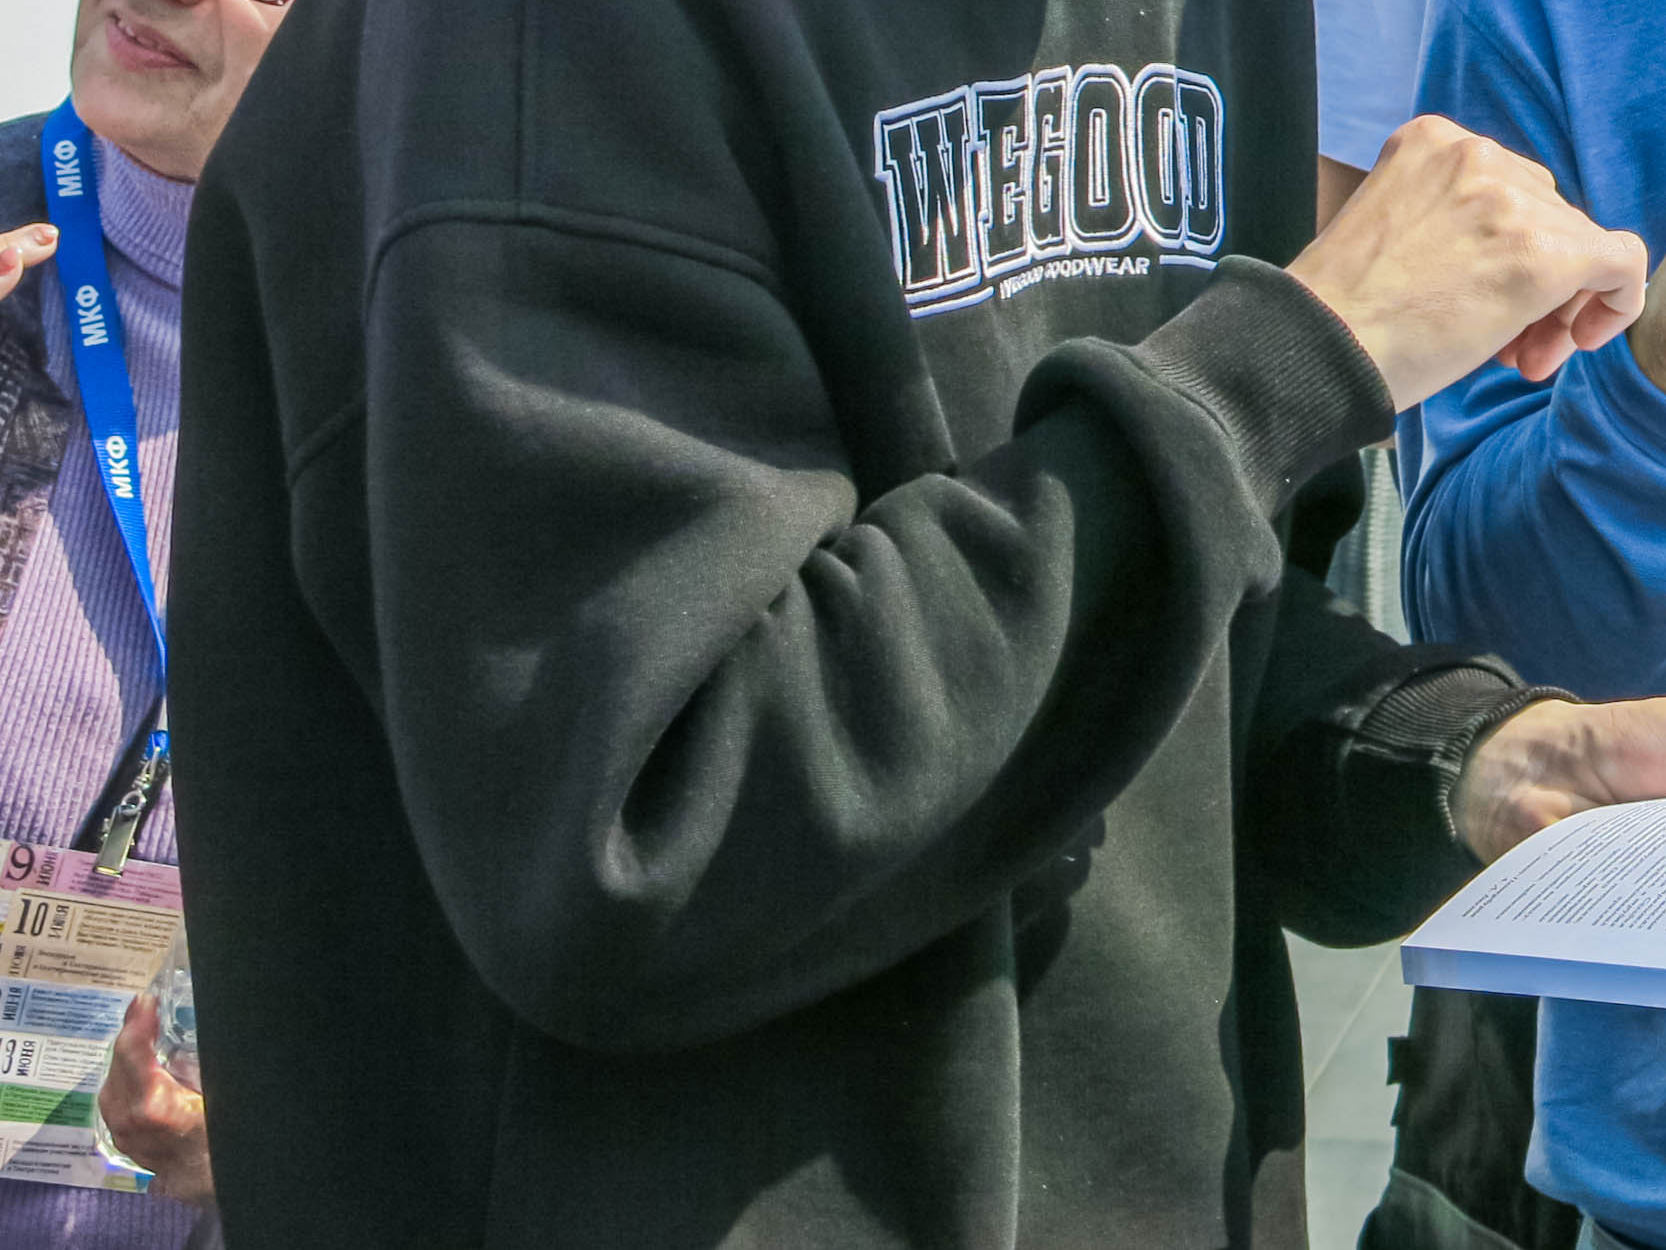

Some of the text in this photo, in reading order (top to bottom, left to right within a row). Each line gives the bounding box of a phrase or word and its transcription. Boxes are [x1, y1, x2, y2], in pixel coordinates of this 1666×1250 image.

[53, 139, 84, 197] МКФ
[874, 63, 1225, 304] WEGOOD
[75, 284, 108, 348] МКФ
[104, 435, 135, 499] МКФ
[5, 844, 36, 883] 9
[13, 897, 49, 938] 10
[0, 1038, 17, 1075] 3
[16, 1040, 37, 1077] ИЮНЯ
